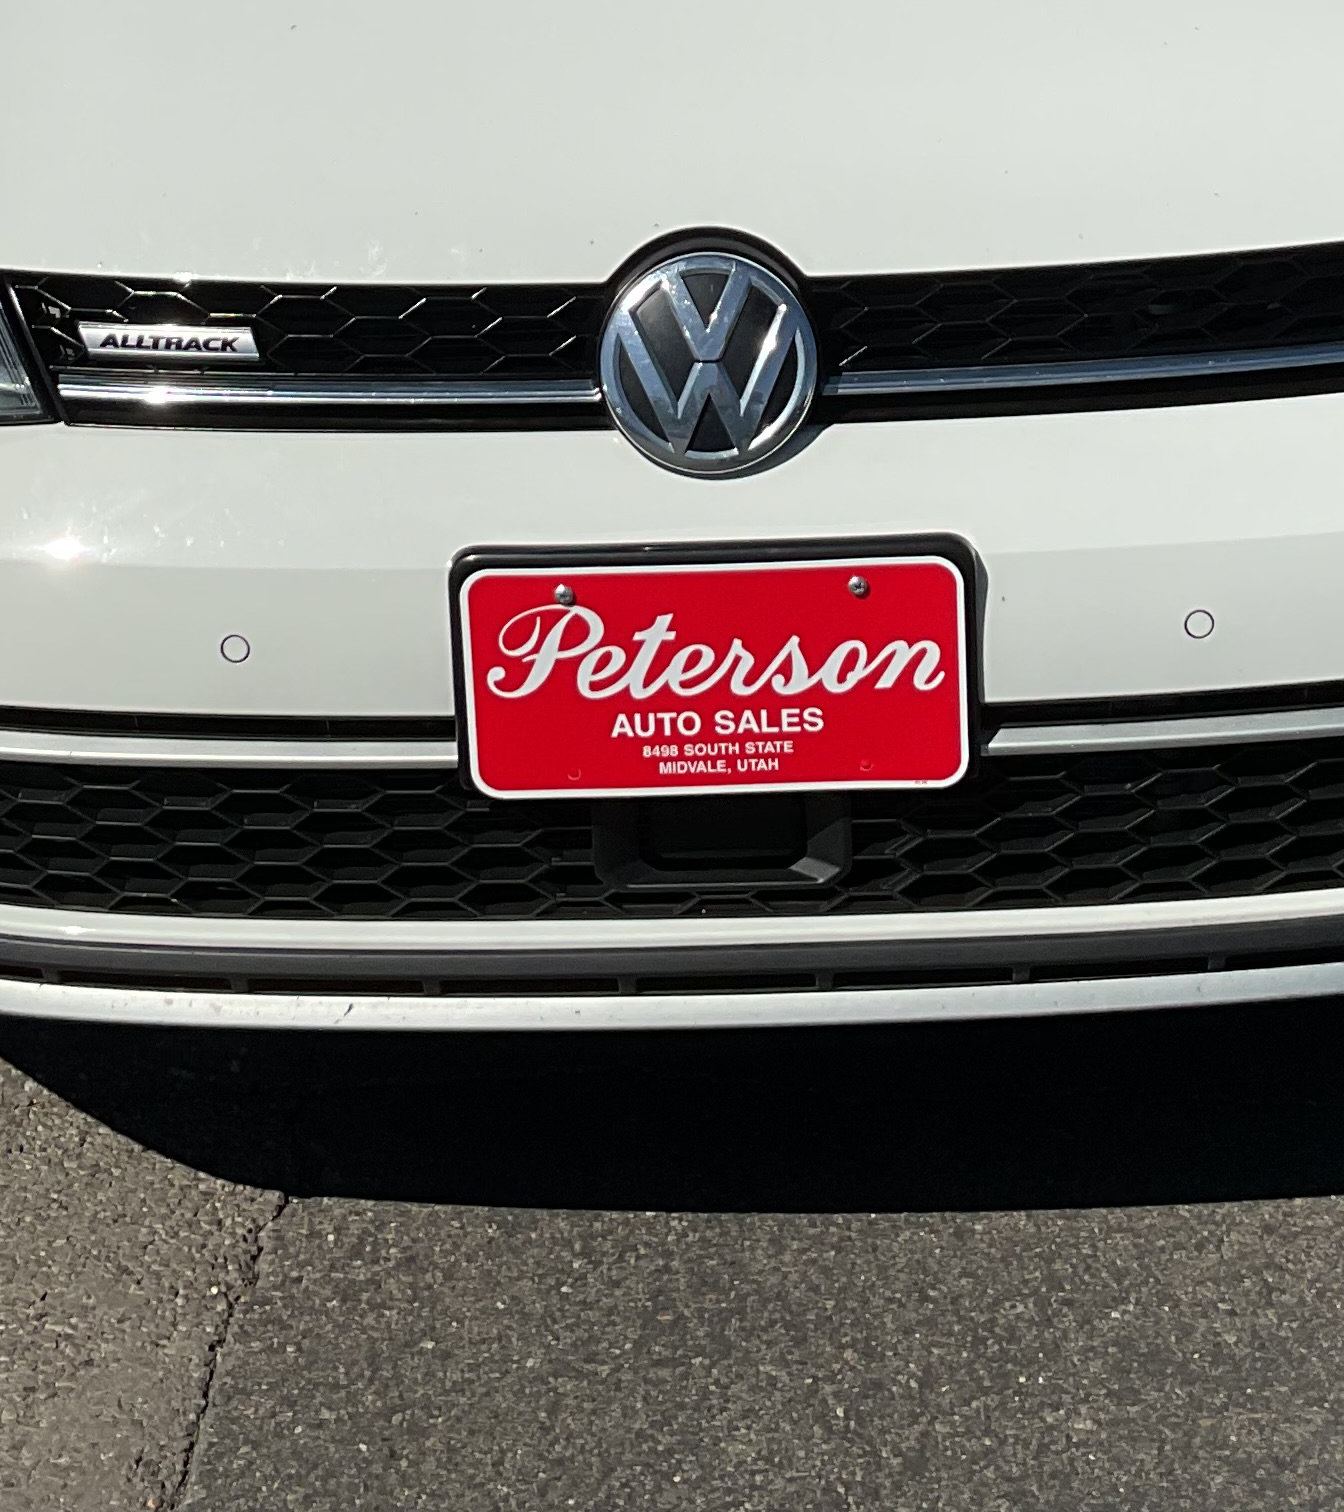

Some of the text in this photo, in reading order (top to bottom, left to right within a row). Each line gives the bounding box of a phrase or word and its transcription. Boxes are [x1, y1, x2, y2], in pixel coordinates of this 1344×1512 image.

[99, 333, 240, 352] ALLTRACK
[487, 603, 946, 700] Peterson
[610, 706, 824, 739] AUTO SALES
[642, 740, 794, 758] 8498 SOUTH STATE
[658, 757, 779, 775] MIDVALE, UTAH
